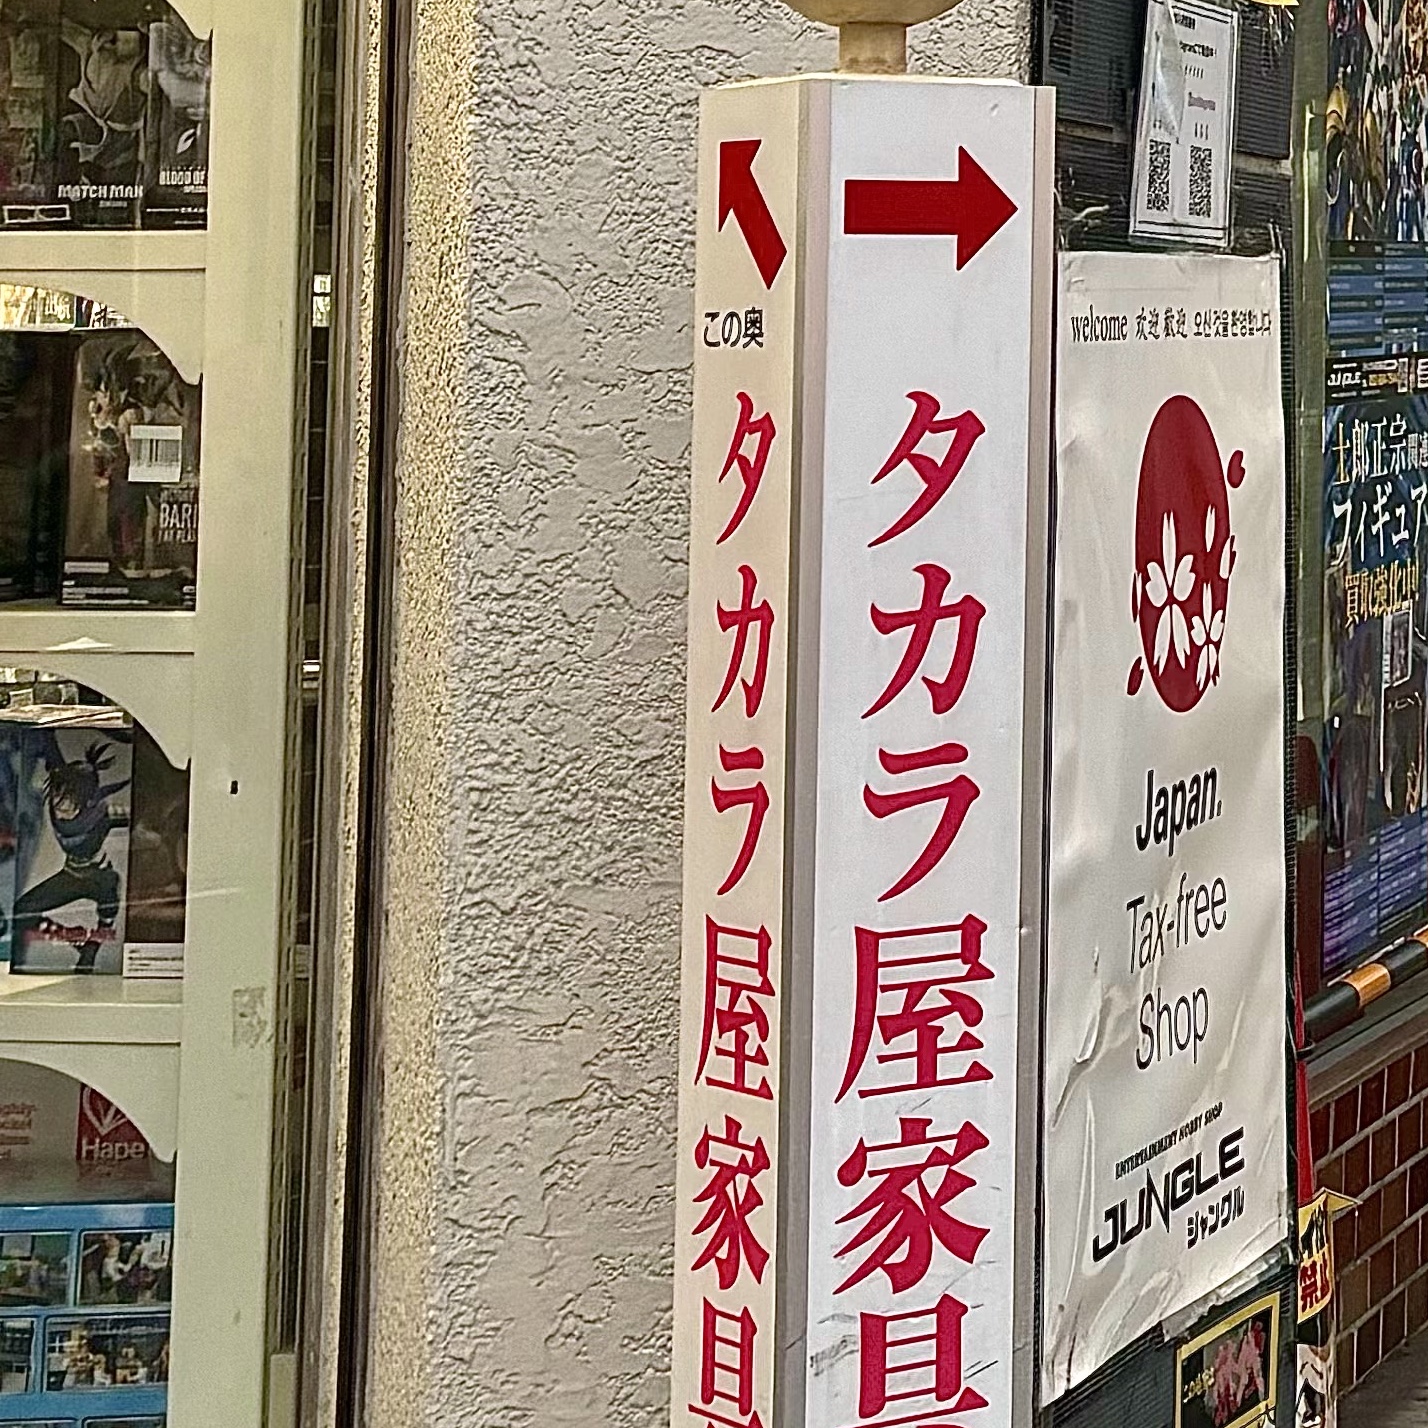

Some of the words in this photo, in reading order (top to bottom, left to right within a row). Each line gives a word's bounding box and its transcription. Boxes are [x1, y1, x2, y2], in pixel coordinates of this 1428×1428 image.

[703, 306, 764, 349] この奥
[1071, 304, 1128, 342] welcome
[1332, 482, 1428, 567] フィギュア
[1136, 766, 1223, 858] Japan.
[1126, 874, 1228, 974] Tax-free
[1136, 986, 1210, 1070] Shop
[82, 1137, 145, 1162] Hape
[1092, 1126, 1245, 1262] JUNGLE
[1187, 1185, 1245, 1249] ジャングル
